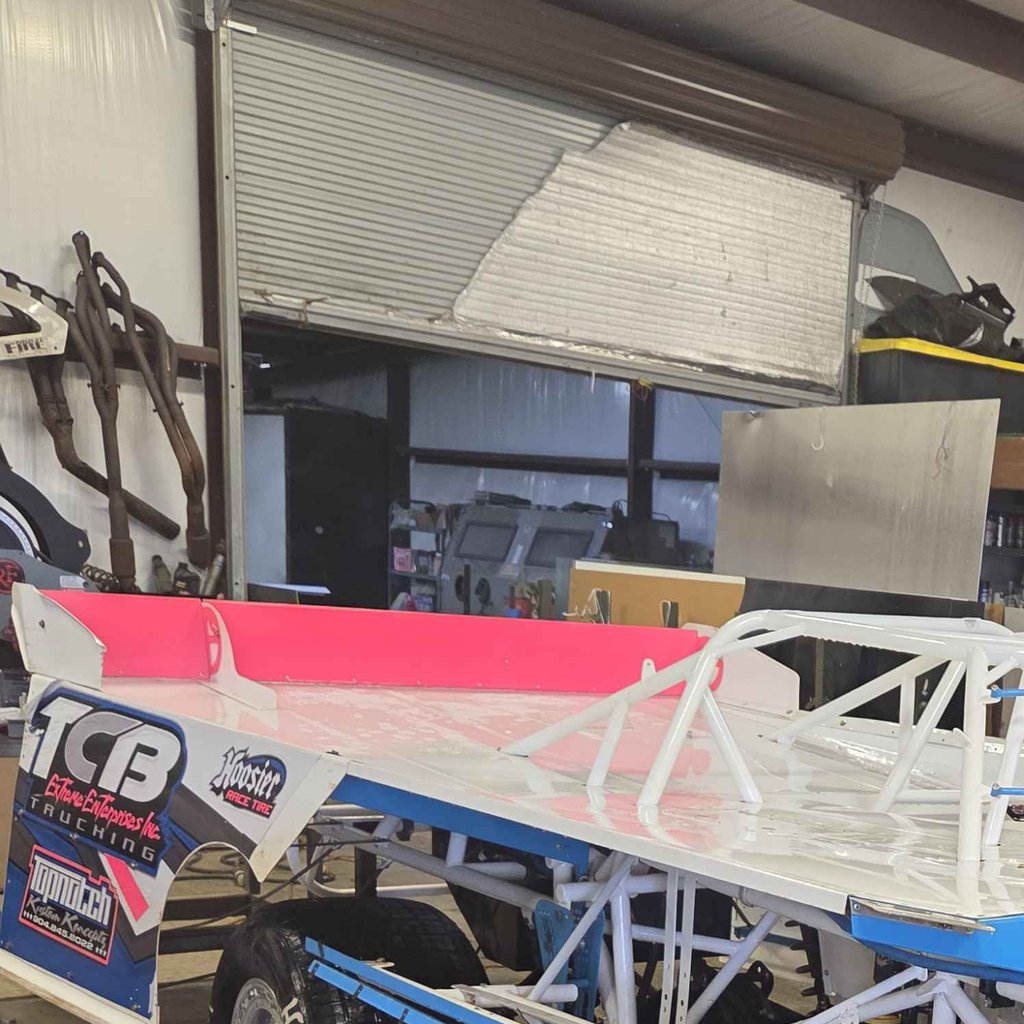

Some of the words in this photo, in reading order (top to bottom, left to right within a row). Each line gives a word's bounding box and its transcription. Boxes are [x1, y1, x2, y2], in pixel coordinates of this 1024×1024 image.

[32, 696, 182, 803] TCB
[211, 748, 281, 800] Hoosier
[30, 795, 156, 862] TRUCKING
[225, 789, 252, 807] RACE
[251, 798, 274, 816] TIRE
